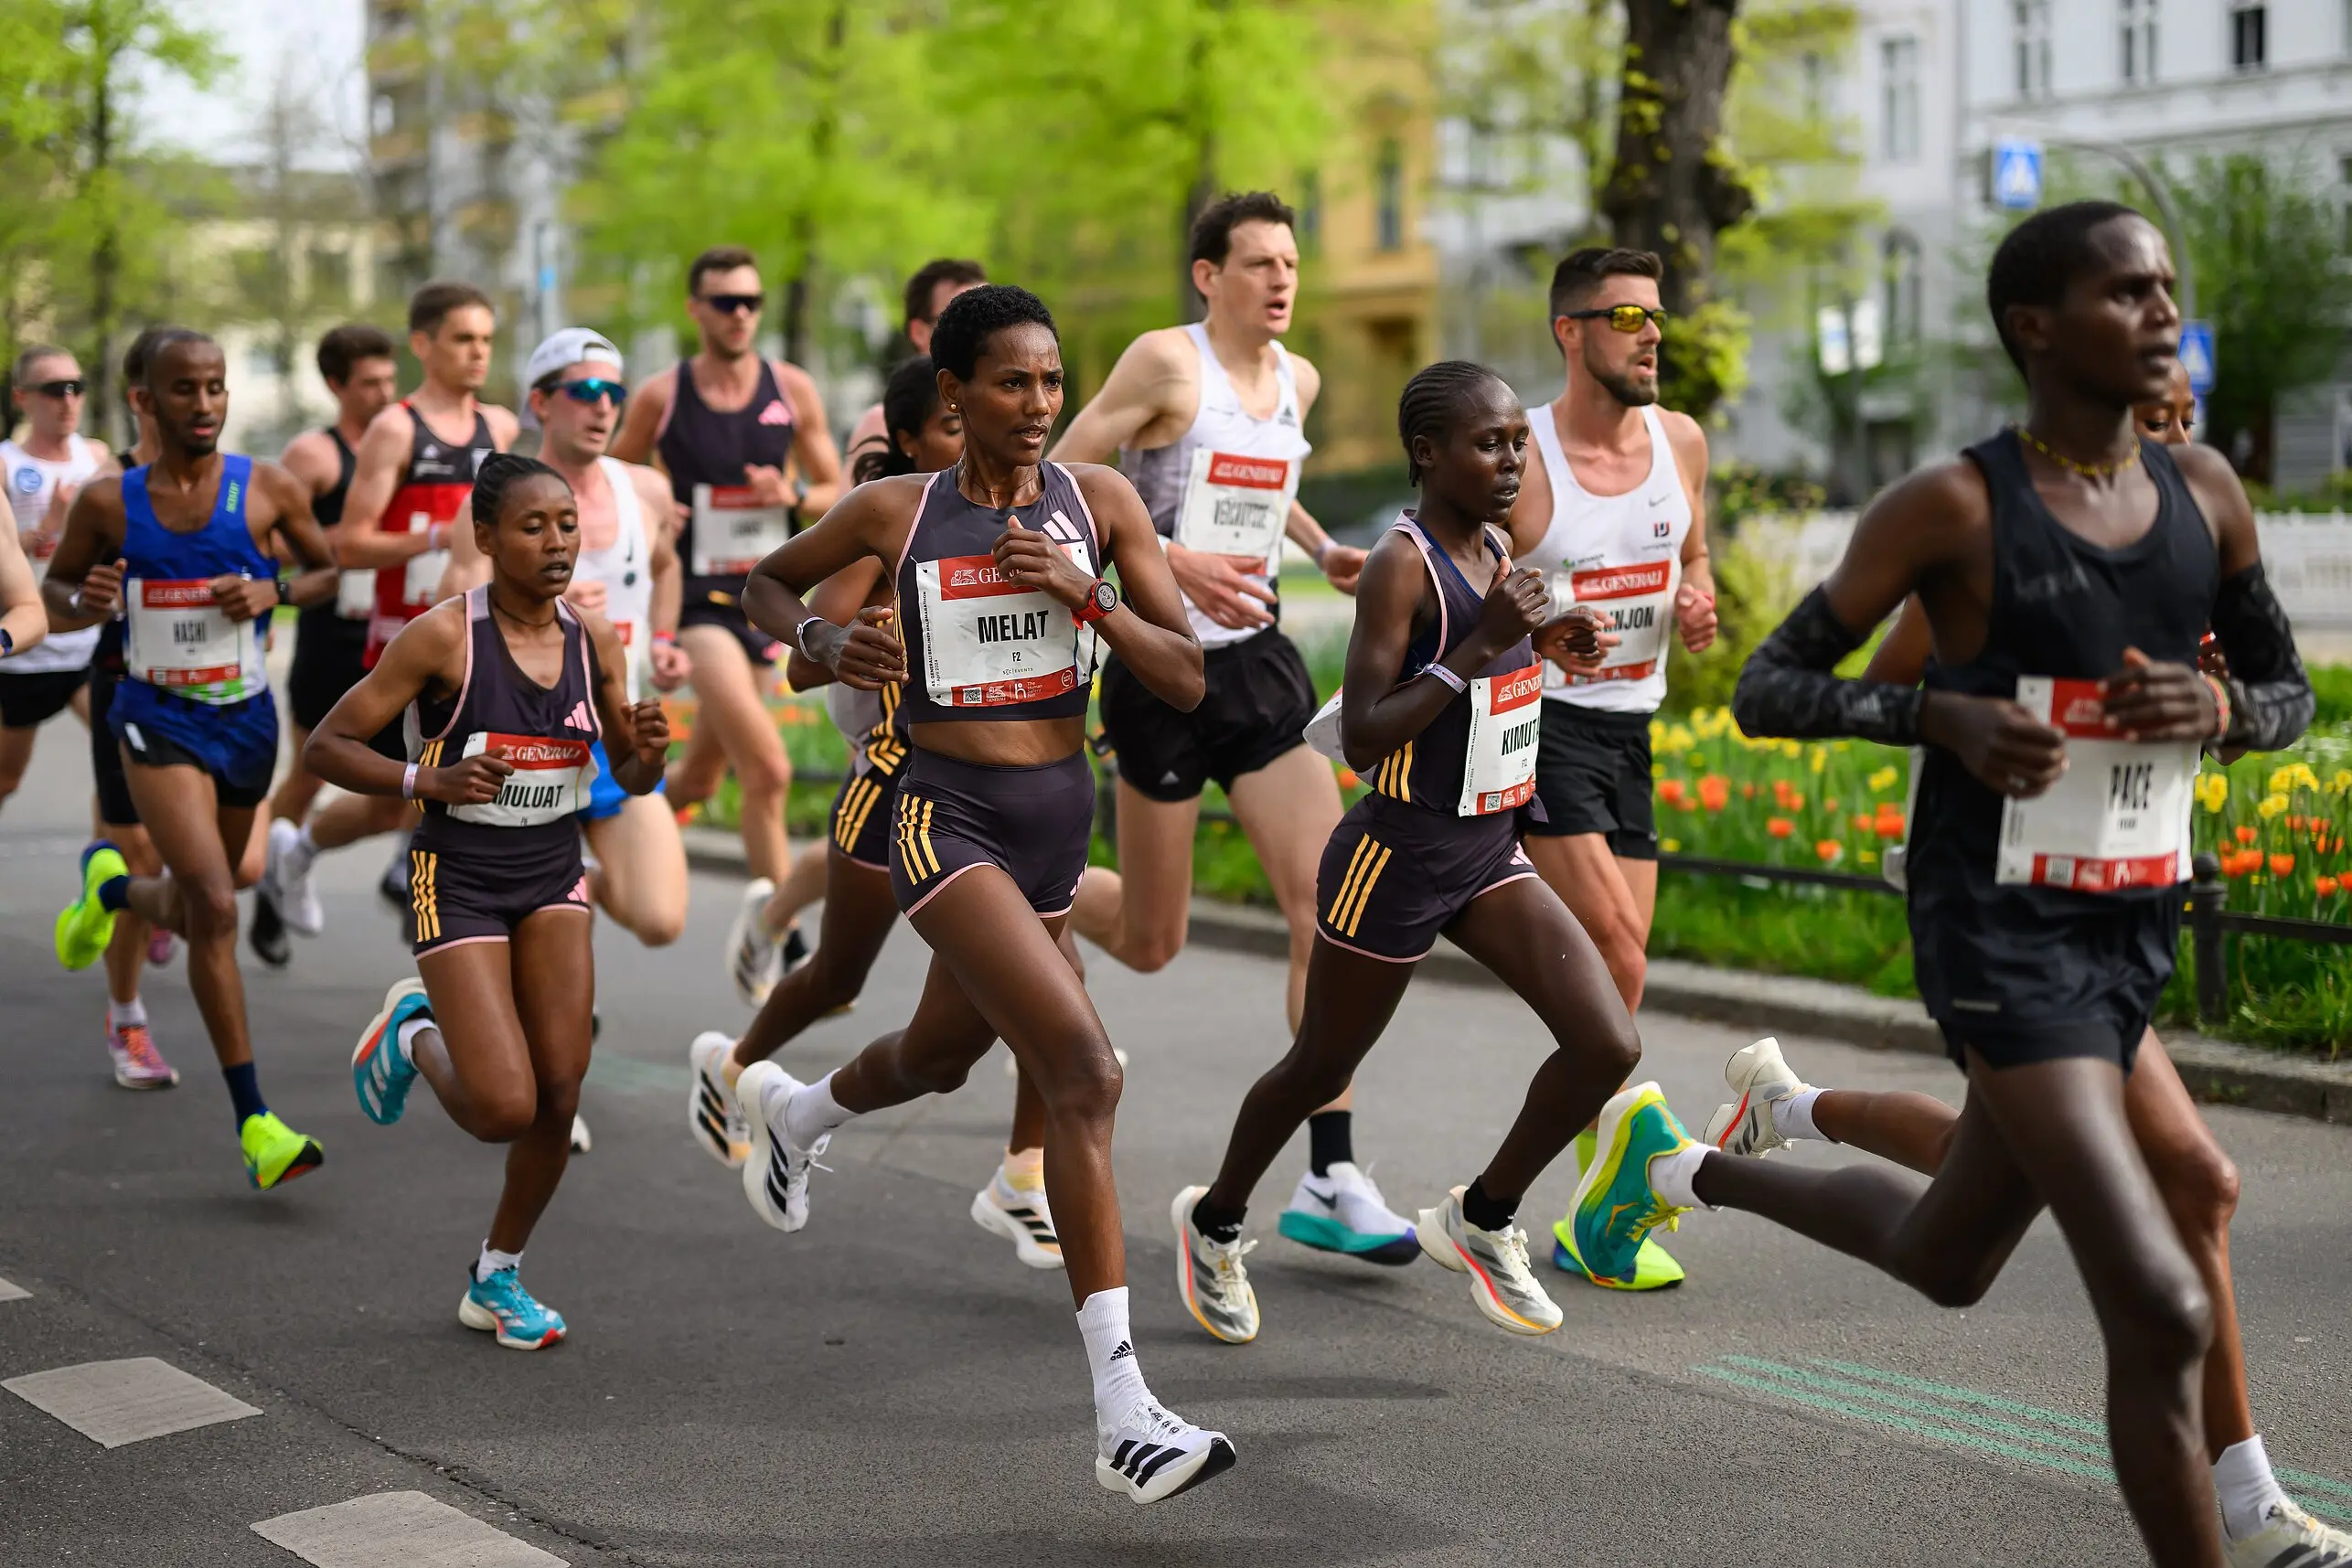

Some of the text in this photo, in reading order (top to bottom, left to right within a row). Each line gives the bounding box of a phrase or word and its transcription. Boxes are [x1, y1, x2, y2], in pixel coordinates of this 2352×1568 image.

[1601, 570, 1663, 592] GENERALI
[978, 610, 1049, 644] MELAT
[1604, 605, 1654, 633] NJON
[1011, 652, 1021, 662] F2
[517, 744, 583, 762] GENERALI
[492, 784, 564, 808] MULUAT
